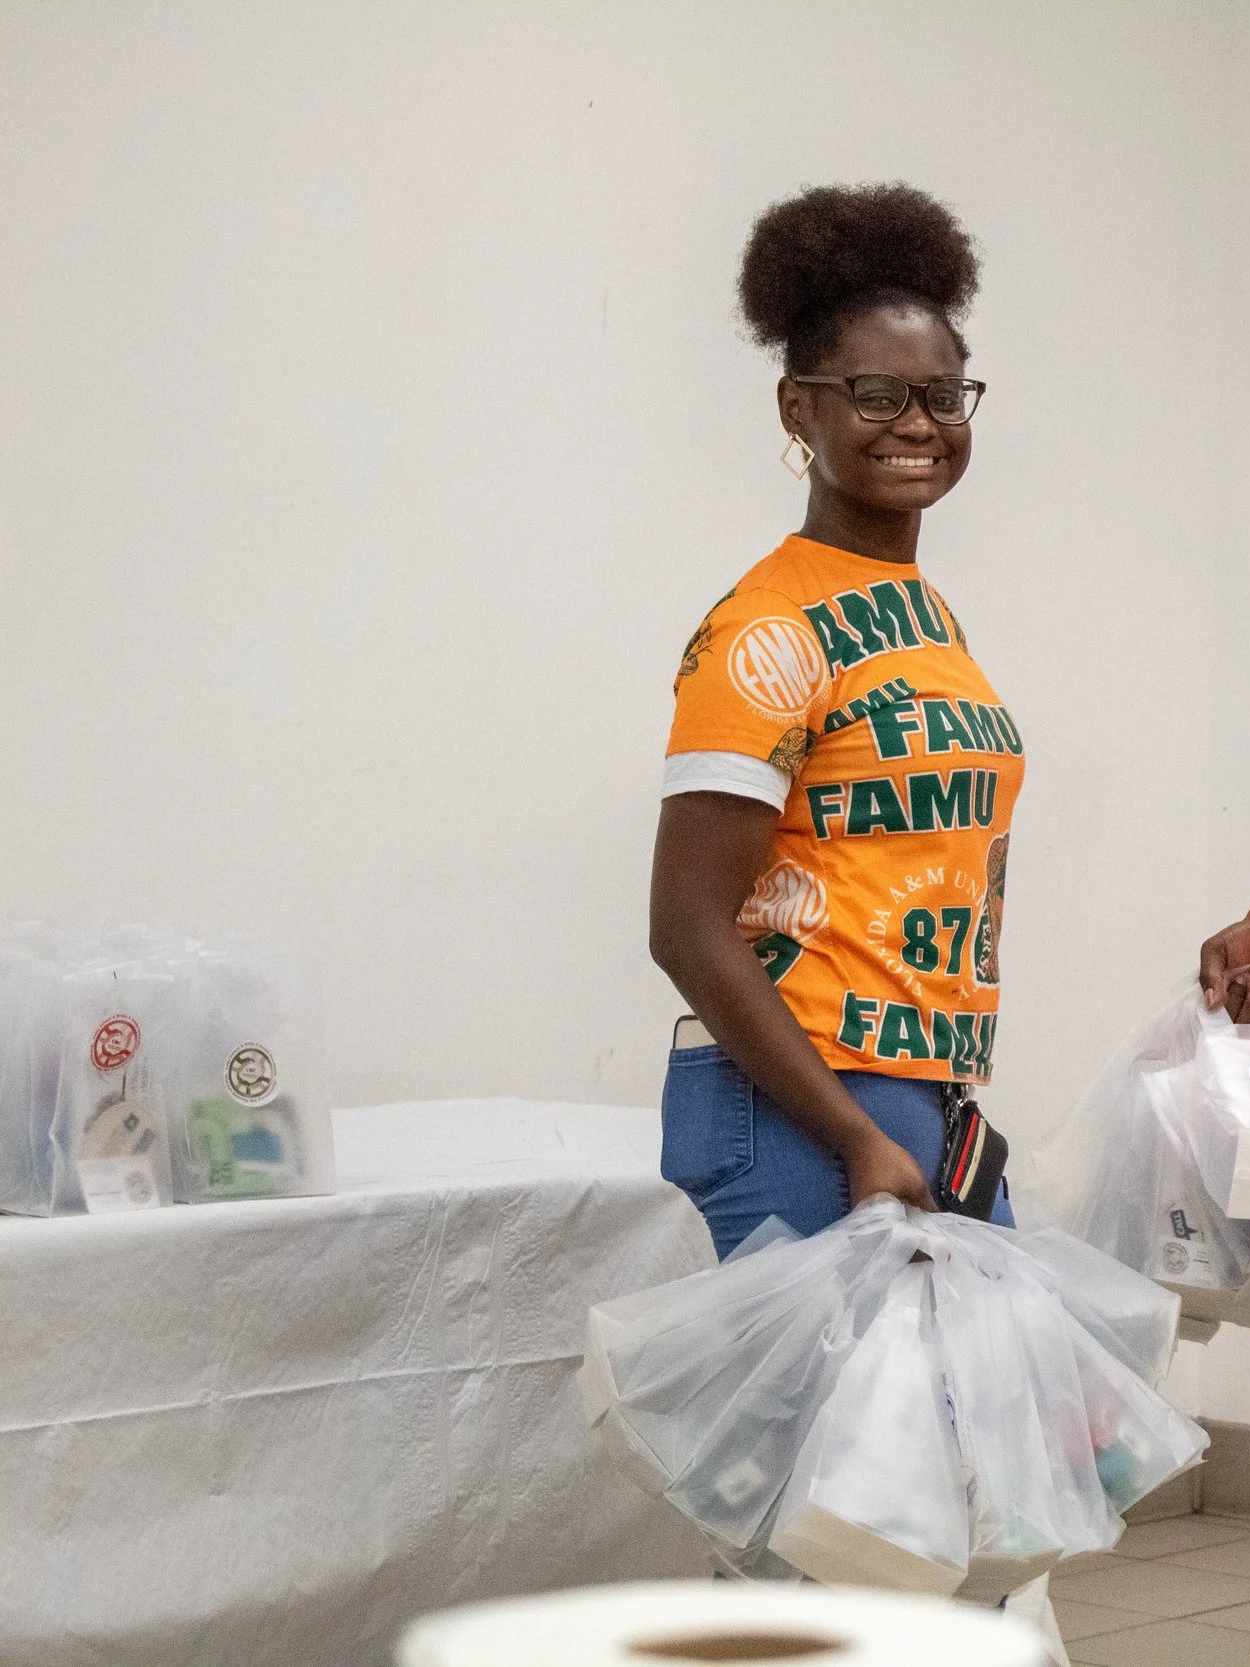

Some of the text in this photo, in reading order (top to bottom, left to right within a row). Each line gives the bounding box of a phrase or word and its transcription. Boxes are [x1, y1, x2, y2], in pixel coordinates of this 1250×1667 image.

[733, 621, 821, 710] FAMU
[866, 698, 1024, 762] FAMU
[804, 768, 999, 841] FAMU
[888, 867, 946, 905] A&M
[900, 905, 973, 977] 87
